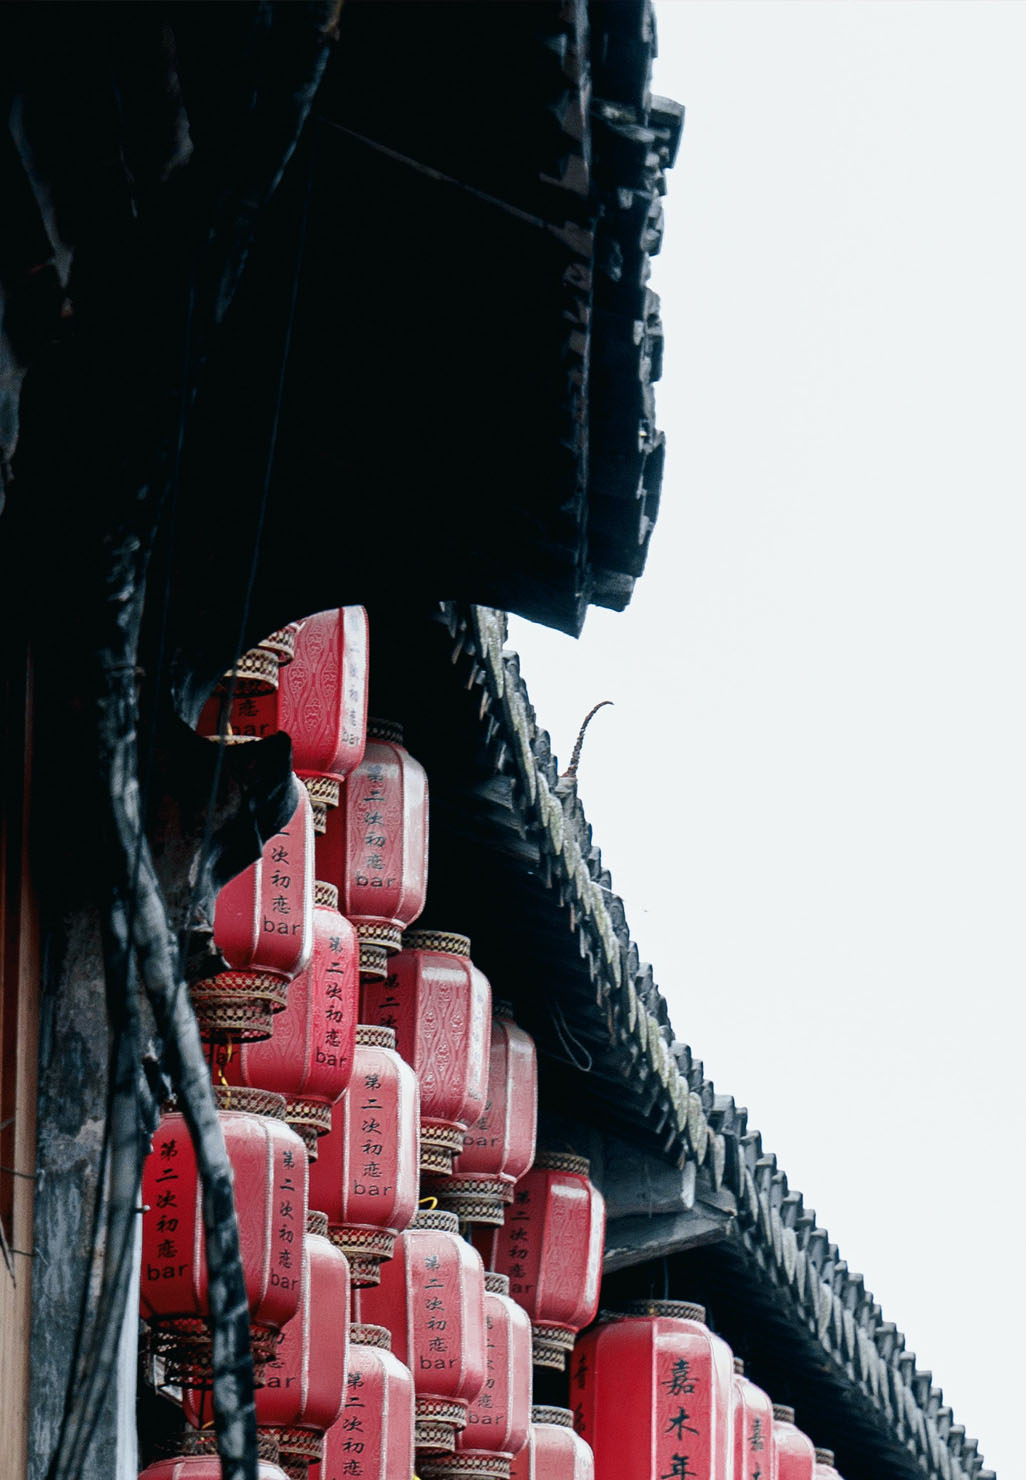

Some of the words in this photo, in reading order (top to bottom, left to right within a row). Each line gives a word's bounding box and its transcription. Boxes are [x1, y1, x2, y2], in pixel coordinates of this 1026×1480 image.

[364, 765, 386, 870] 第二次初恋
[271, 831, 291, 915] 次初恋
[355, 870, 397, 888] bar
[263, 916, 301, 936] bar
[325, 937, 344, 1047] 第二次初恋
[315, 1048, 347, 1068] bar
[361, 1073, 383, 1177] 第二次初恋
[155, 1140, 179, 1259] 第二次初恋
[353, 1180, 393, 1196] bar
[279, 1151, 295, 1268] 第二次初恋
[509, 1190, 530, 1279] 第二次初恋
[147, 1263, 188, 1281] bar
[270, 1268, 299, 1291] bar
[512, 1283, 535, 1294] ar
[424, 1256, 449, 1352] 第二次初恋
[419, 1355, 458, 1370] bar
[267, 1375, 296, 1388] ar
[343, 1373, 365, 1476] 第二次初恋
[468, 1408, 504, 1425] bar
